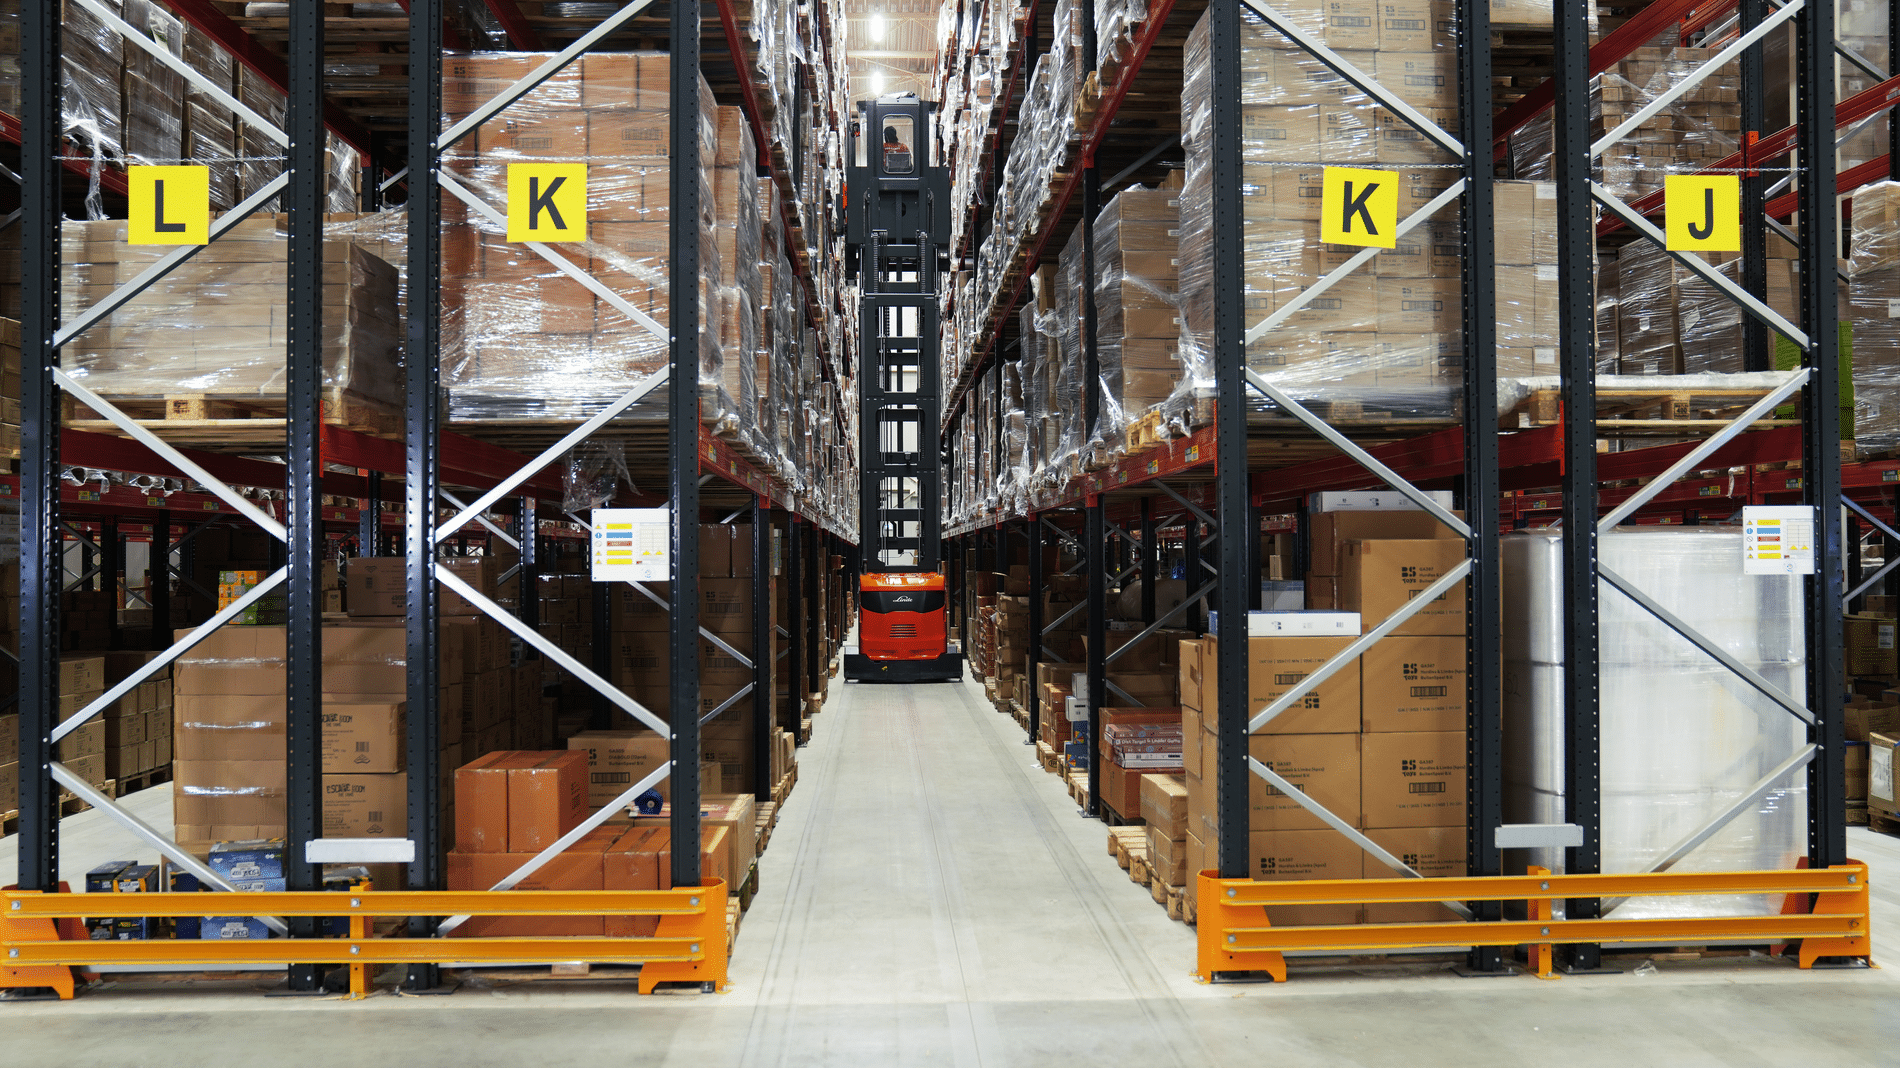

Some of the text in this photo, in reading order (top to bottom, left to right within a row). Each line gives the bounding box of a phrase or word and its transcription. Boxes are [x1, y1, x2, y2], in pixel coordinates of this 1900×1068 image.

[155, 180, 186, 232] L
[529, 177, 568, 230] K
[1342, 181, 1380, 235] K
[1688, 188, 1713, 240] J
[1402, 567, 1416, 577] BS
[1403, 663, 1417, 674] BS
[1305, 698, 1319, 709] BS
[1402, 760, 1416, 770] BS
[326, 784, 350, 793] ESCAPE
[1261, 858, 1275, 868] BS
